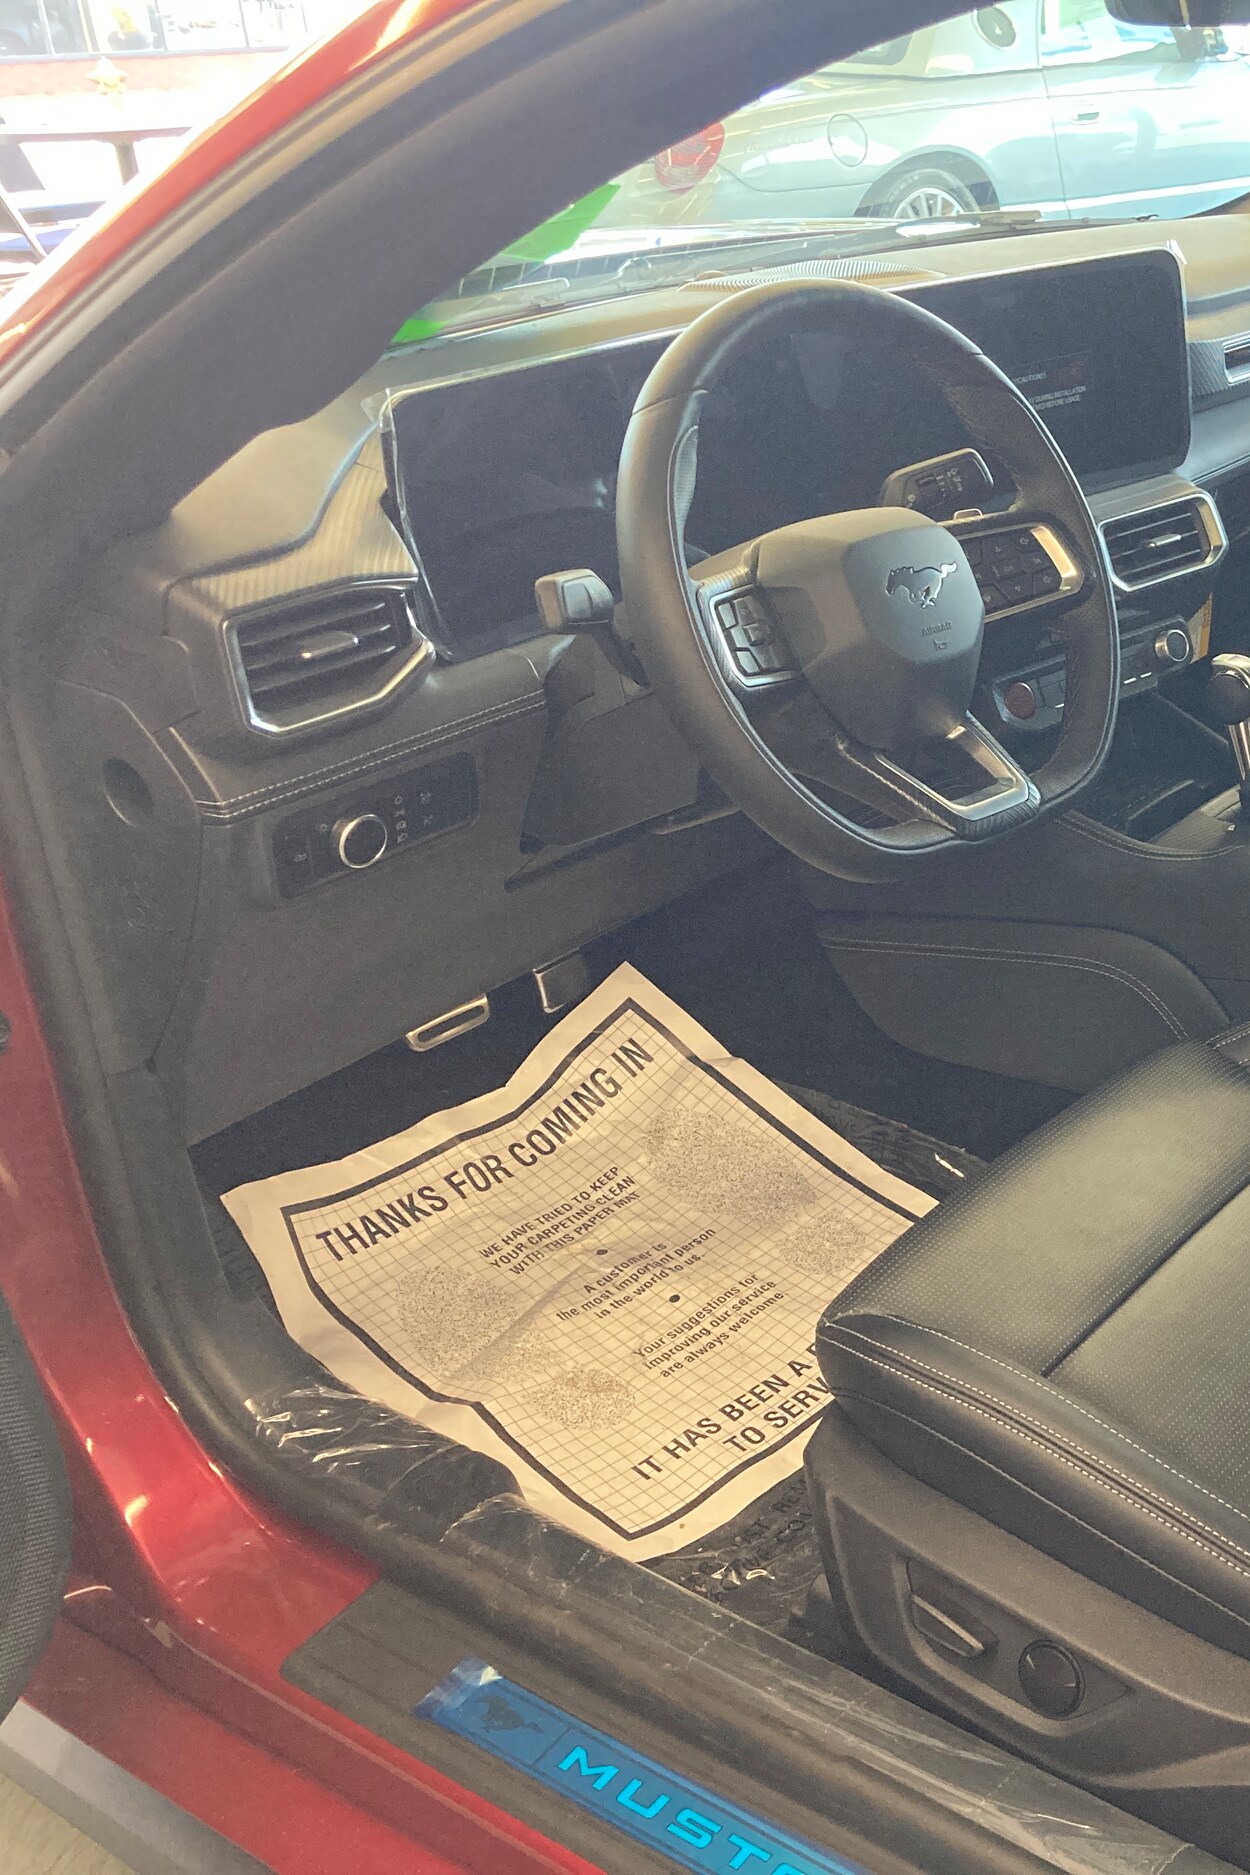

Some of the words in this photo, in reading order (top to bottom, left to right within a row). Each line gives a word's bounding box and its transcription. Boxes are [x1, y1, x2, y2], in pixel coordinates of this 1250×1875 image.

[920, 620, 953, 637] AIRBAG
[315, 1186, 449, 1262] THANKS
[444, 1155, 514, 1200] FOR
[508, 1067, 623, 1167] COMING
[611, 1037, 654, 1078] IN
[479, 1242, 503, 1259] WE
[501, 1222, 536, 1246] HAVE
[534, 1203, 573, 1226] TRIED
[571, 1191, 591, 1204] TO
[589, 1166, 619, 1192] KEEP
[490, 1242, 528, 1269] YOUR
[527, 1203, 596, 1246] CARPETING
[595, 1175, 636, 1206] CLEAN
[509, 1250, 545, 1275] WITH
[543, 1233, 575, 1252] THIS
[574, 1207, 615, 1236] PAPER
[613, 1191, 641, 1208] MAT
[556, 1307, 580, 1321] the
[581, 1289, 615, 1311] most
[613, 1253, 675, 1292] important
[674, 1228, 716, 1257] person
[583, 1284, 596, 1293] A
[596, 1250, 653, 1287] customer
[652, 1242, 667, 1252] is
[595, 1309, 611, 1319] in
[610, 1294, 634, 1310] the
[633, 1270, 670, 1296] world
[667, 1263, 684, 1273] to
[632, 1336, 666, 1358] Your
[666, 1286, 741, 1339] suggestions
[738, 1273, 760, 1288] for
[643, 1326, 711, 1370] improving
[709, 1310, 733, 1328] our
[731, 1280, 777, 1312] service
[660, 1361, 684, 1378] are
[684, 1331, 730, 1364] always
[631, 1455, 663, 1481] IT
[661, 1417, 722, 1460] HAS
[719, 1374, 790, 1422] BEEN
[787, 1360, 813, 1377] A
[722, 1426, 766, 1453] TO
[763, 1376, 831, 1429] SERV
